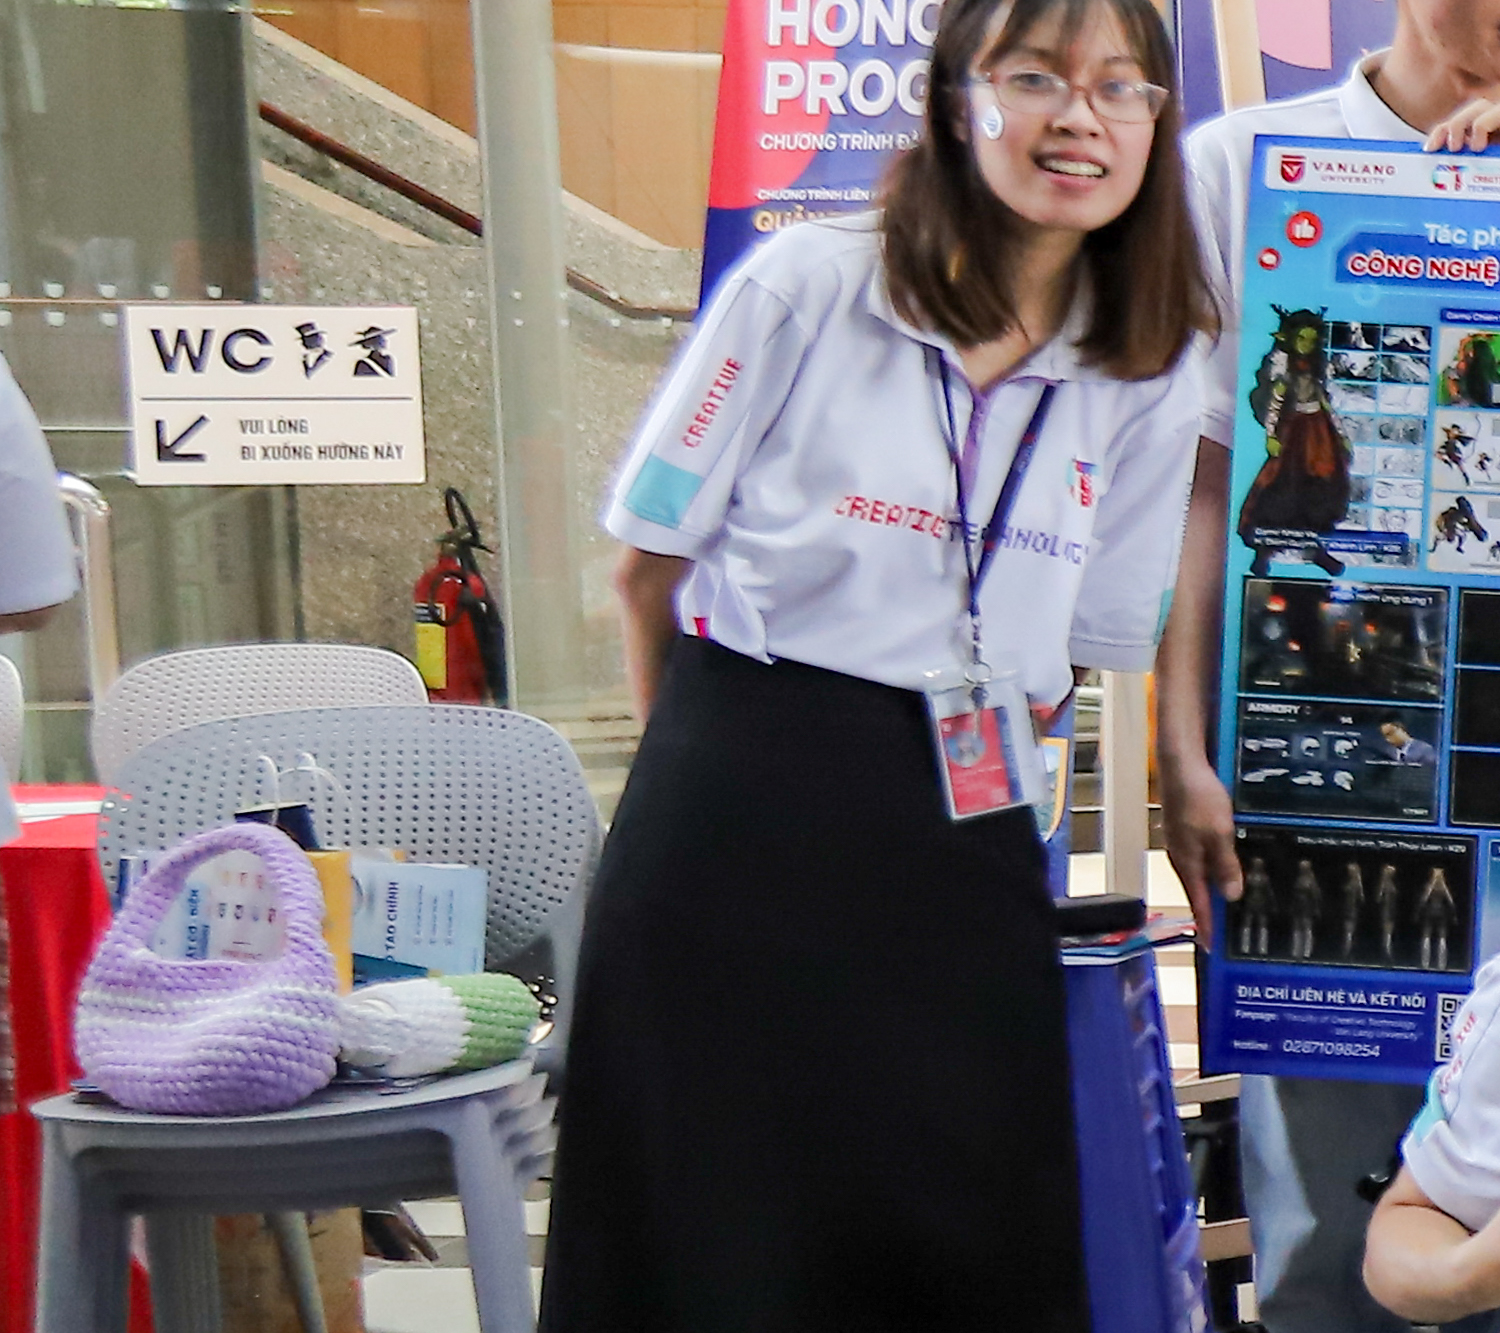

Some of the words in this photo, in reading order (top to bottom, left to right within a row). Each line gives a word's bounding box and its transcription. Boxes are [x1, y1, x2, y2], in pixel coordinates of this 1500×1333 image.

[761, 58, 931, 117] PROG
[759, 131, 837, 151] CHƯƠNG
[838, 129, 894, 151] TRÌNH
[1312, 162, 1397, 175] VANLANG
[1424, 222, 1467, 247] Tác
[1348, 251, 1423, 279] CÔNG
[1426, 256, 1499, 289] NGHỆ
[150, 328, 273, 374] WC
[240, 419, 264, 435] VUI
[268, 414, 309, 435] LÒNG
[240, 445, 257, 461] ĐI
[260, 439, 313, 461] XUỐNG
[317, 440, 370, 461] HƯỚNG
[373, 441, 404, 461] NÀY
[1237, 985, 1261, 999] ĐỊA
[1265, 986, 1289, 1000] CHỈ
[1292, 987, 1323, 1002] LIÊN
[1327, 989, 1345, 1004] HỆ
[1349, 990, 1367, 1005] VÀ
[1370, 990, 1396, 1006] KẾT
[1401, 991, 1426, 1008] NỐI
